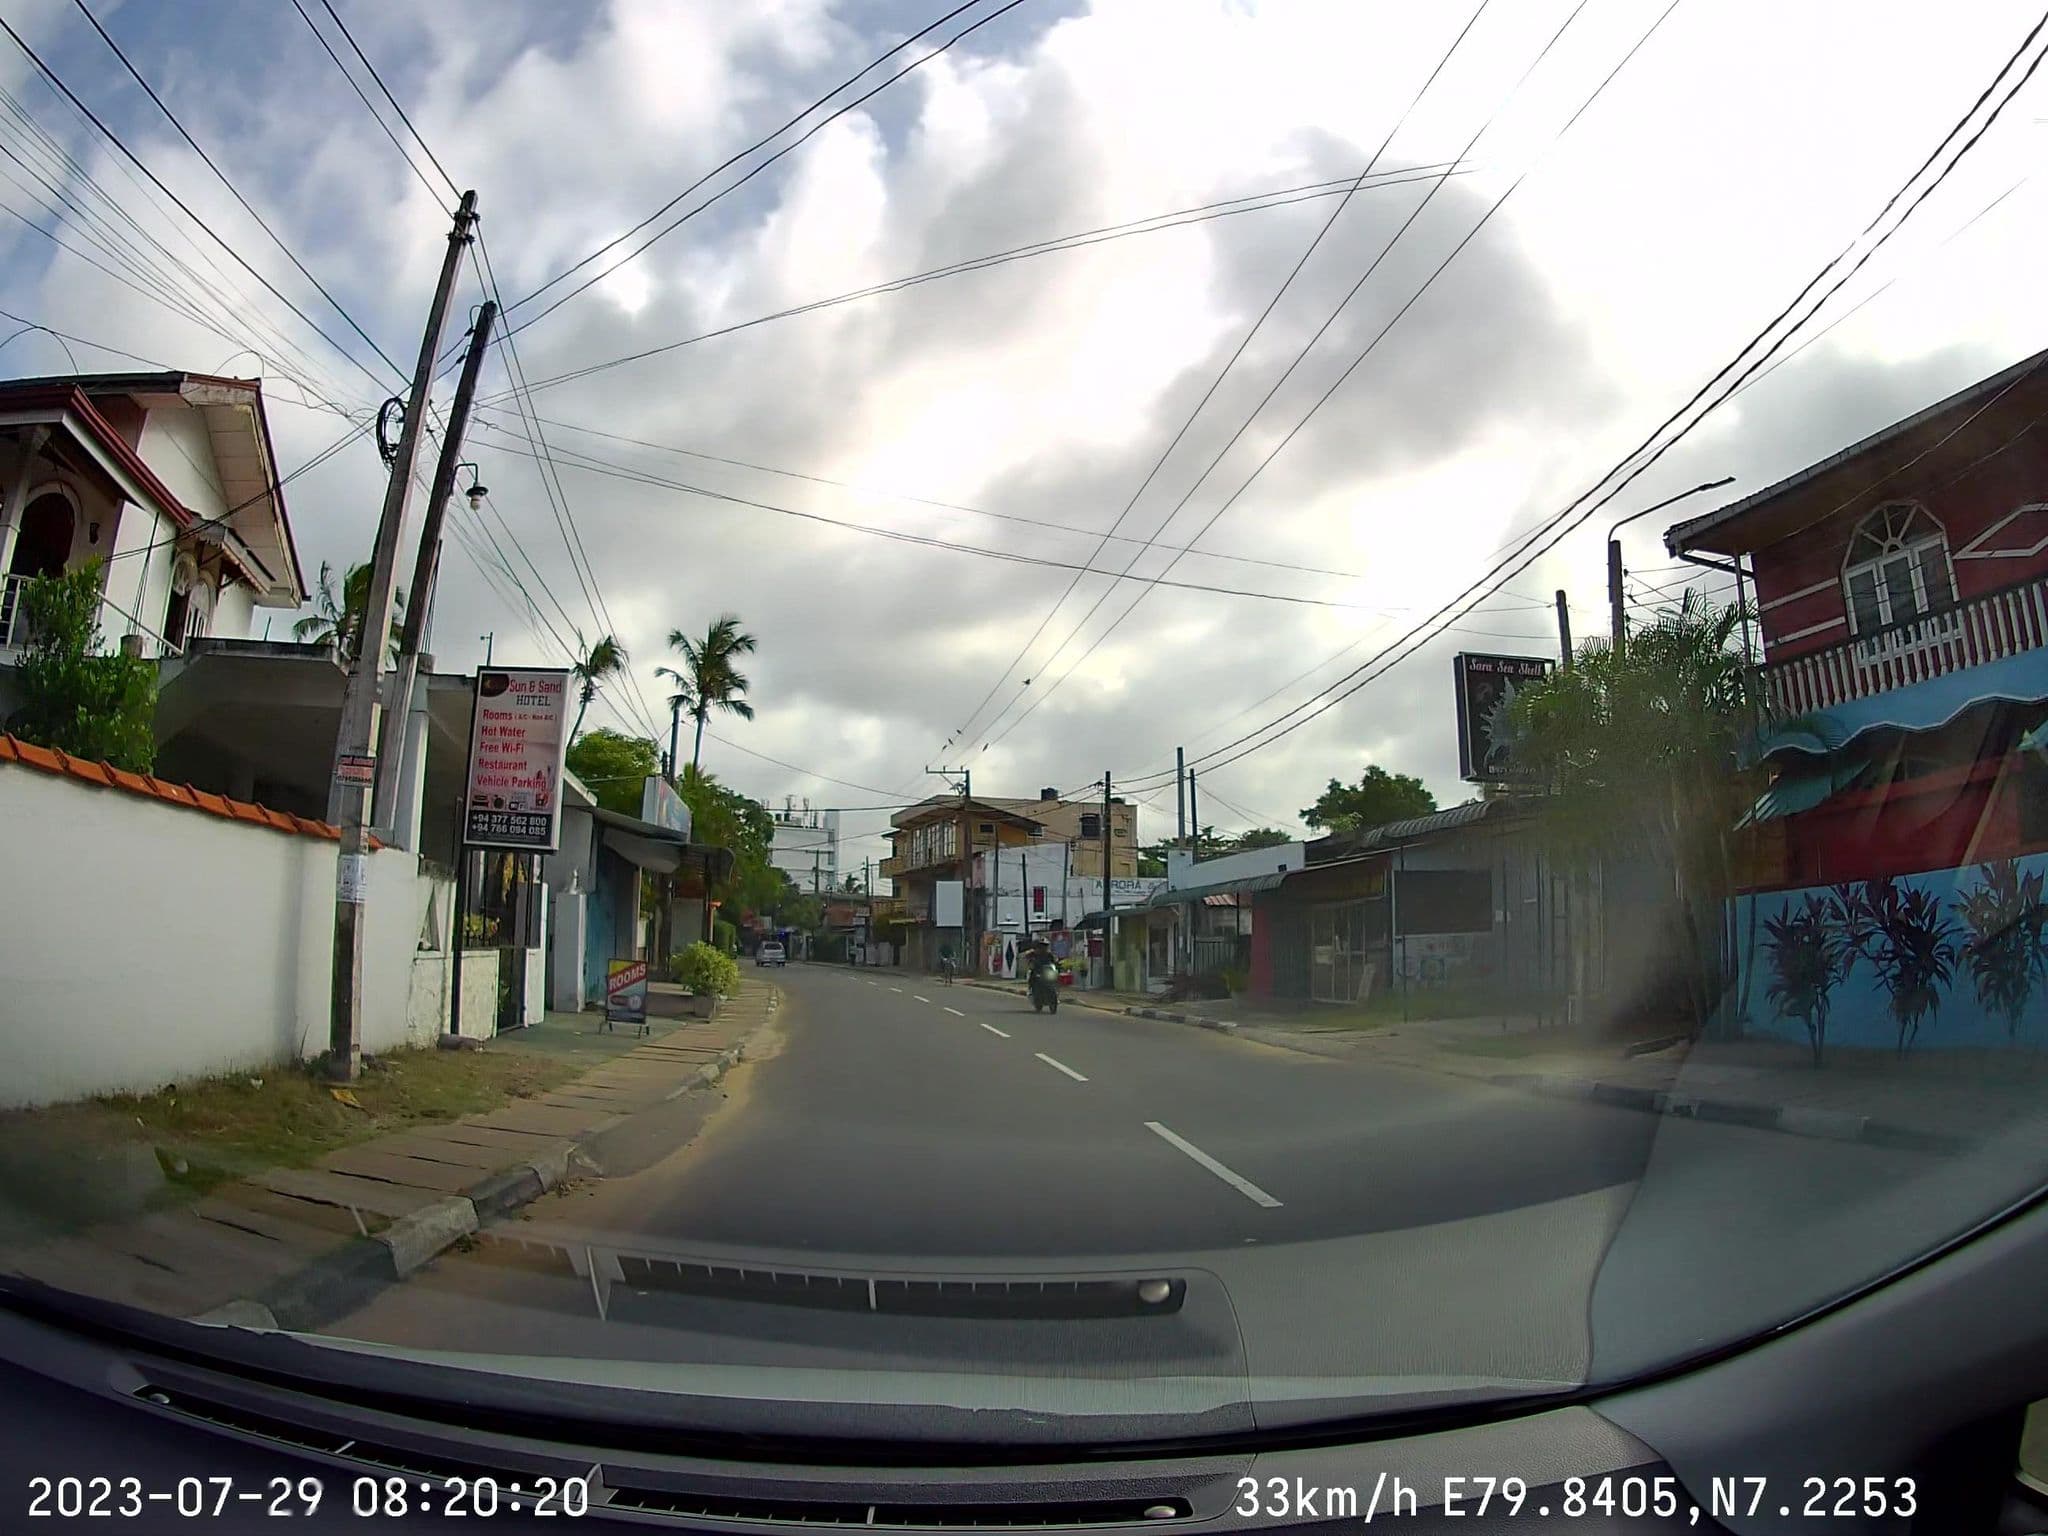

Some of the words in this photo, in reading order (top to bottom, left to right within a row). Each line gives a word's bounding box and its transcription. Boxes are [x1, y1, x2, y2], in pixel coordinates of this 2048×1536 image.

[1469, 658, 1492, 672] Sara
[1497, 660, 1514, 673] Sea
[1518, 662, 1541, 675] Shell
[509, 679, 526, 693] Sun
[538, 680, 562, 693] Sand
[516, 694, 551, 706] HOTEL
[482, 709, 513, 721] Rooms
[481, 725, 498, 737] Hot
[499, 726, 526, 738] Water
[479, 742, 499, 753] Free
[501, 742, 524, 754] Wi-Fi
[478, 758, 527, 771] Restaurant
[477, 774, 509, 787] Vehicle
[511, 775, 547, 791] Parking
[472, 814, 489, 823] +94
[472, 823, 488, 832] +94
[1096, 880, 1142, 889] ARORA
[608, 963, 646, 991] ROOMS
